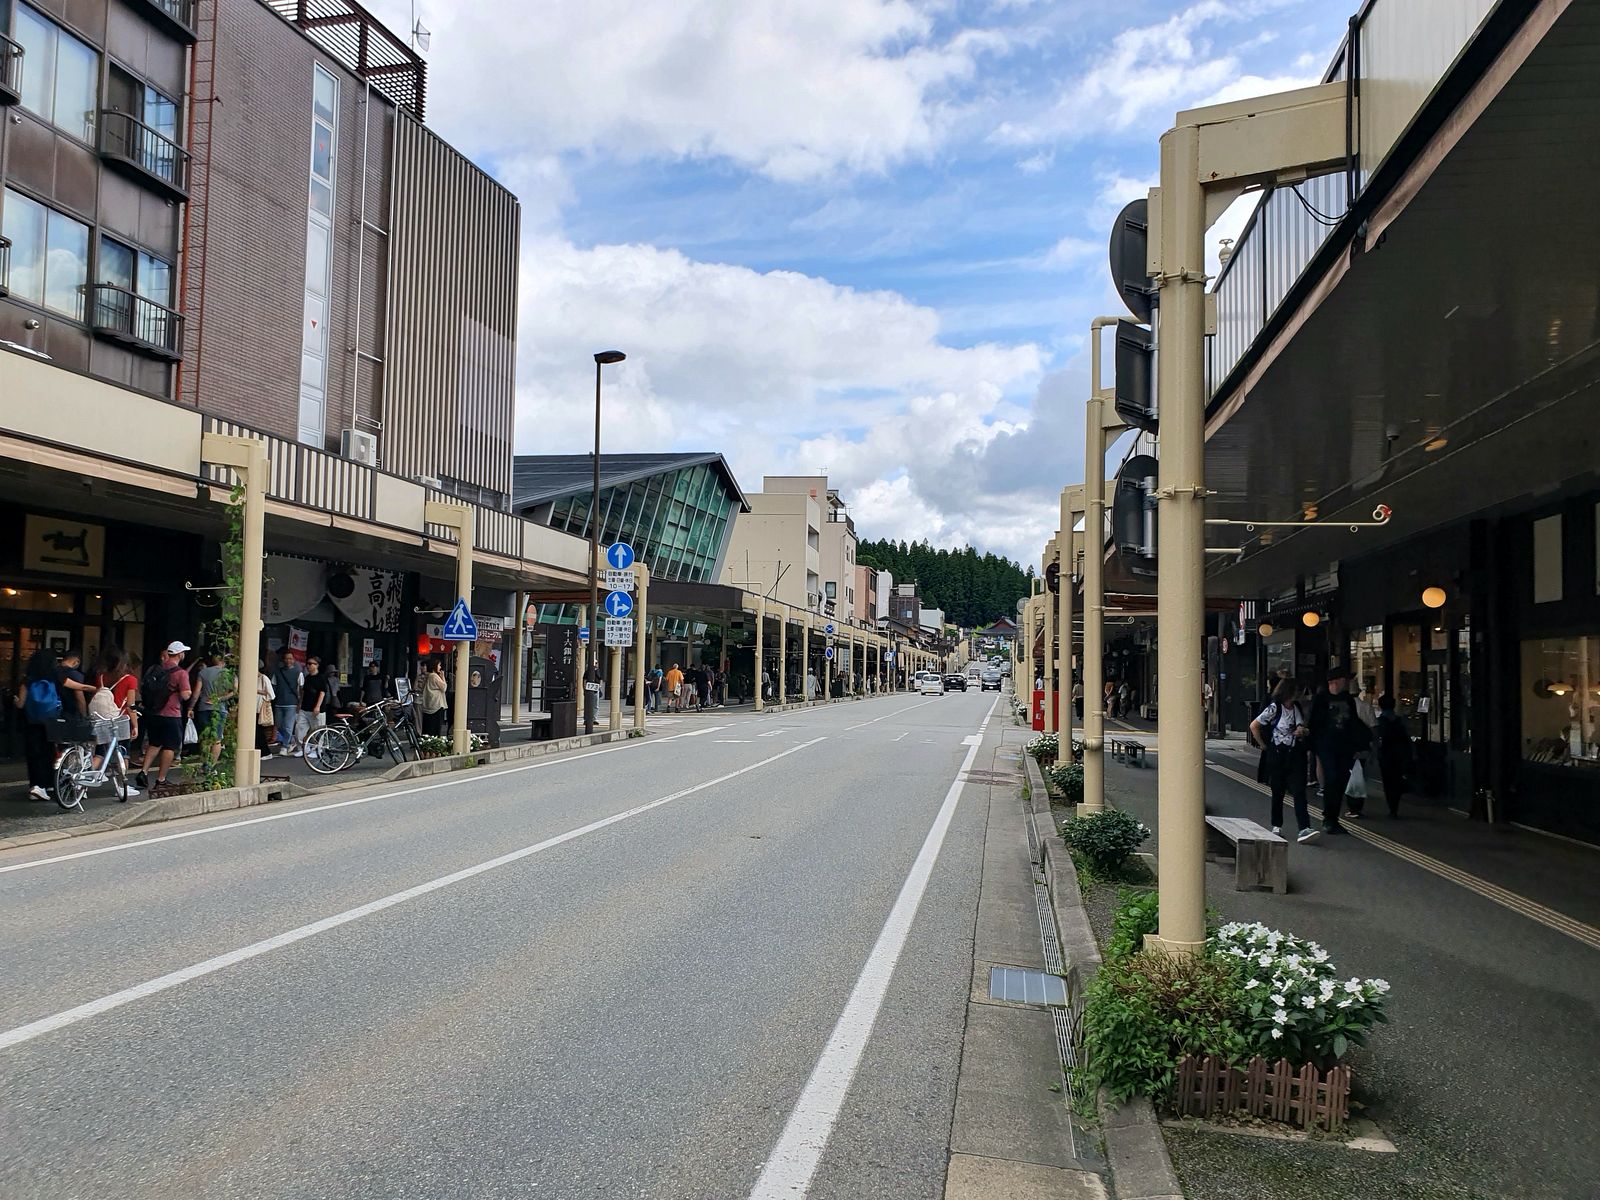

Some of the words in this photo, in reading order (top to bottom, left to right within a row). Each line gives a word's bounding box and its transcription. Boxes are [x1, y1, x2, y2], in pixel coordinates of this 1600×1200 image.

[364, 571, 386, 631] 高山
[563, 629, 574, 665] 十六銀行
